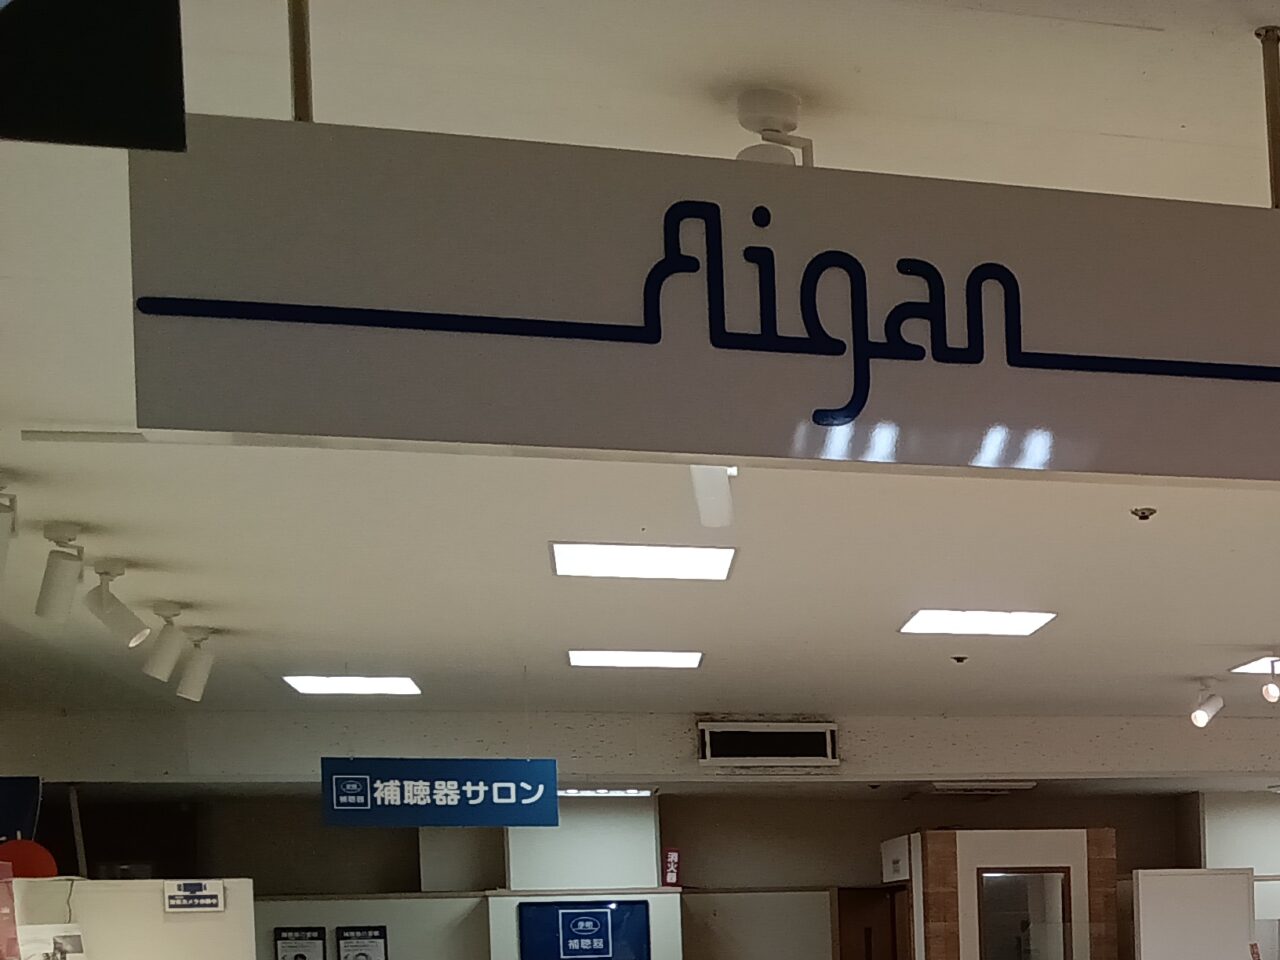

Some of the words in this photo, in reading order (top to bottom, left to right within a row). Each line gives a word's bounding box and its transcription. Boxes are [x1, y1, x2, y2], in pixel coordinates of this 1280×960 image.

[644, 200, 1022, 427] Aigan
[372, 779, 545, 806] 補聴器サロン
[568, 938, 604, 950] 補聴器
